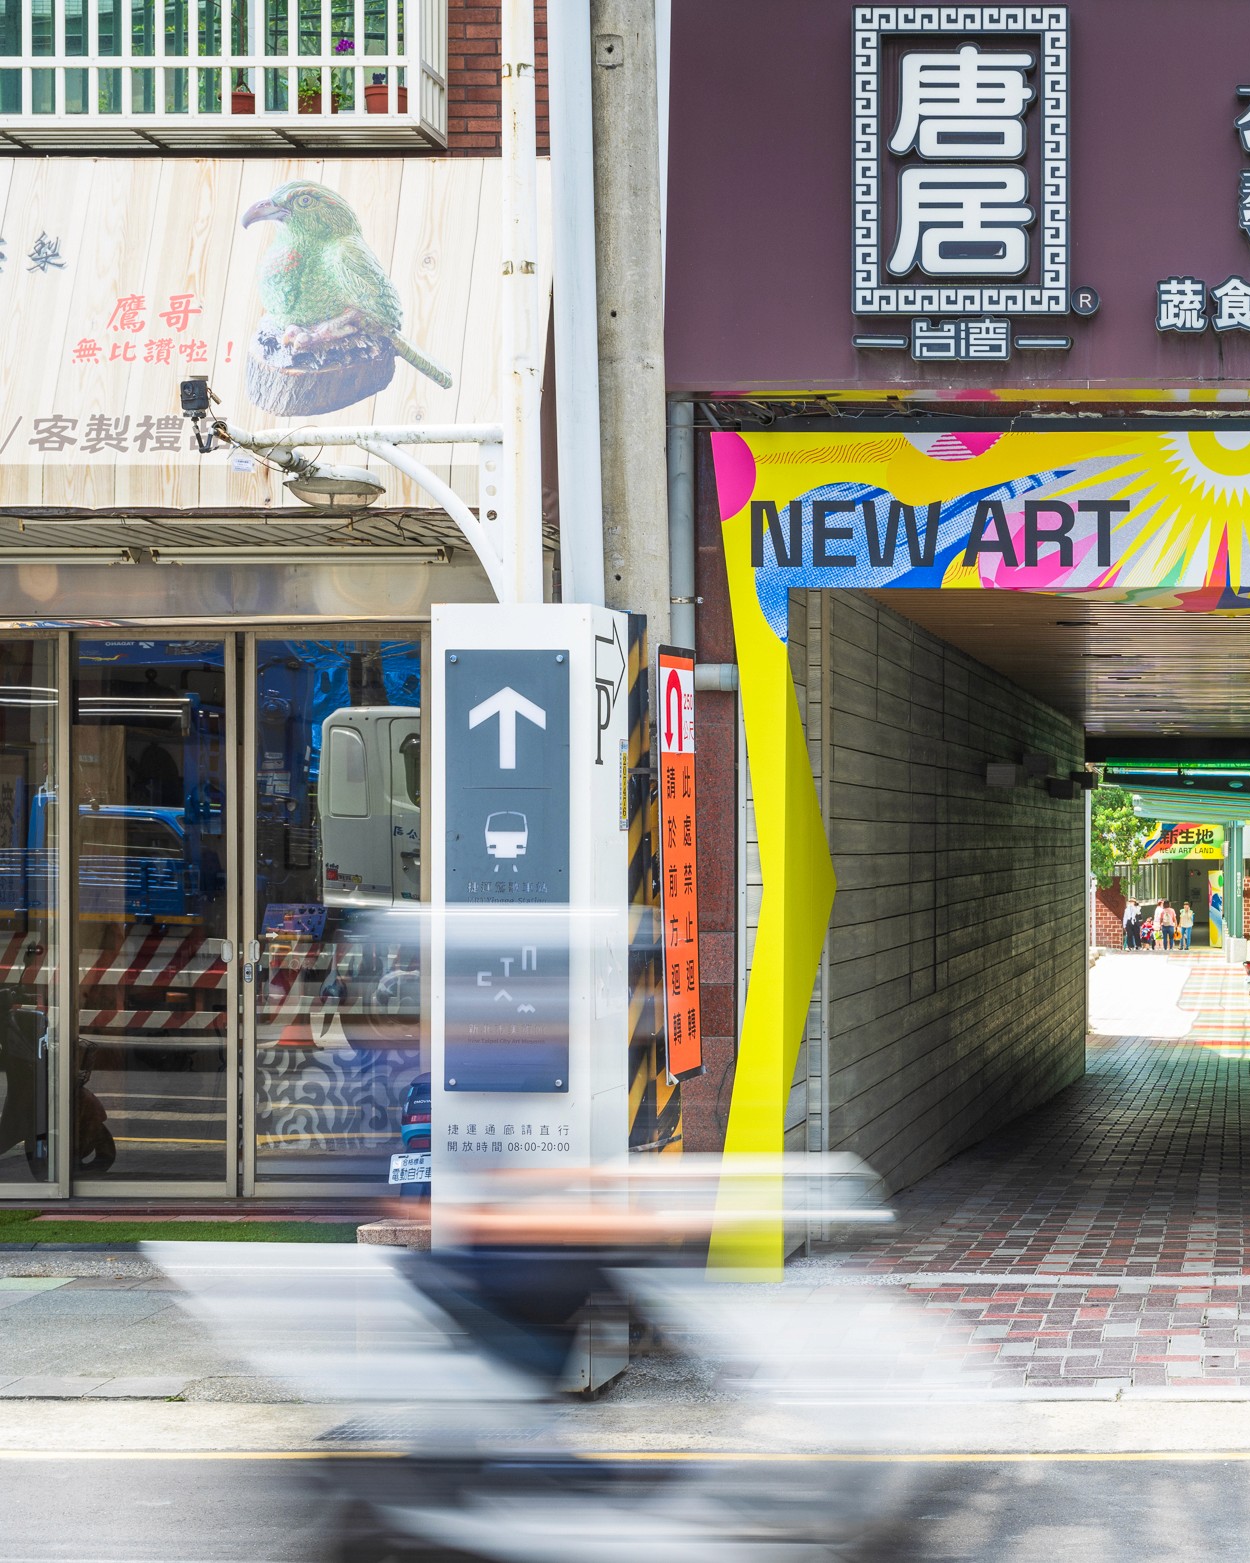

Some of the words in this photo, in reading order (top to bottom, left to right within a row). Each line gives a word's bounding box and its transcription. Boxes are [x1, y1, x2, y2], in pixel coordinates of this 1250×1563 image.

[888, 43, 1036, 277] 唐居
[106, 293, 203, 333] 鷹哥
[750, 500, 942, 568] NEW
[962, 500, 1131, 568] ART
[1160, 829, 1214, 845] 新生地
[447, 1124, 570, 1136] 捷運通廊請直行
[447, 1141, 503, 1152] 開放時間
[507, 1141, 570, 1152] 08:00-20:00
